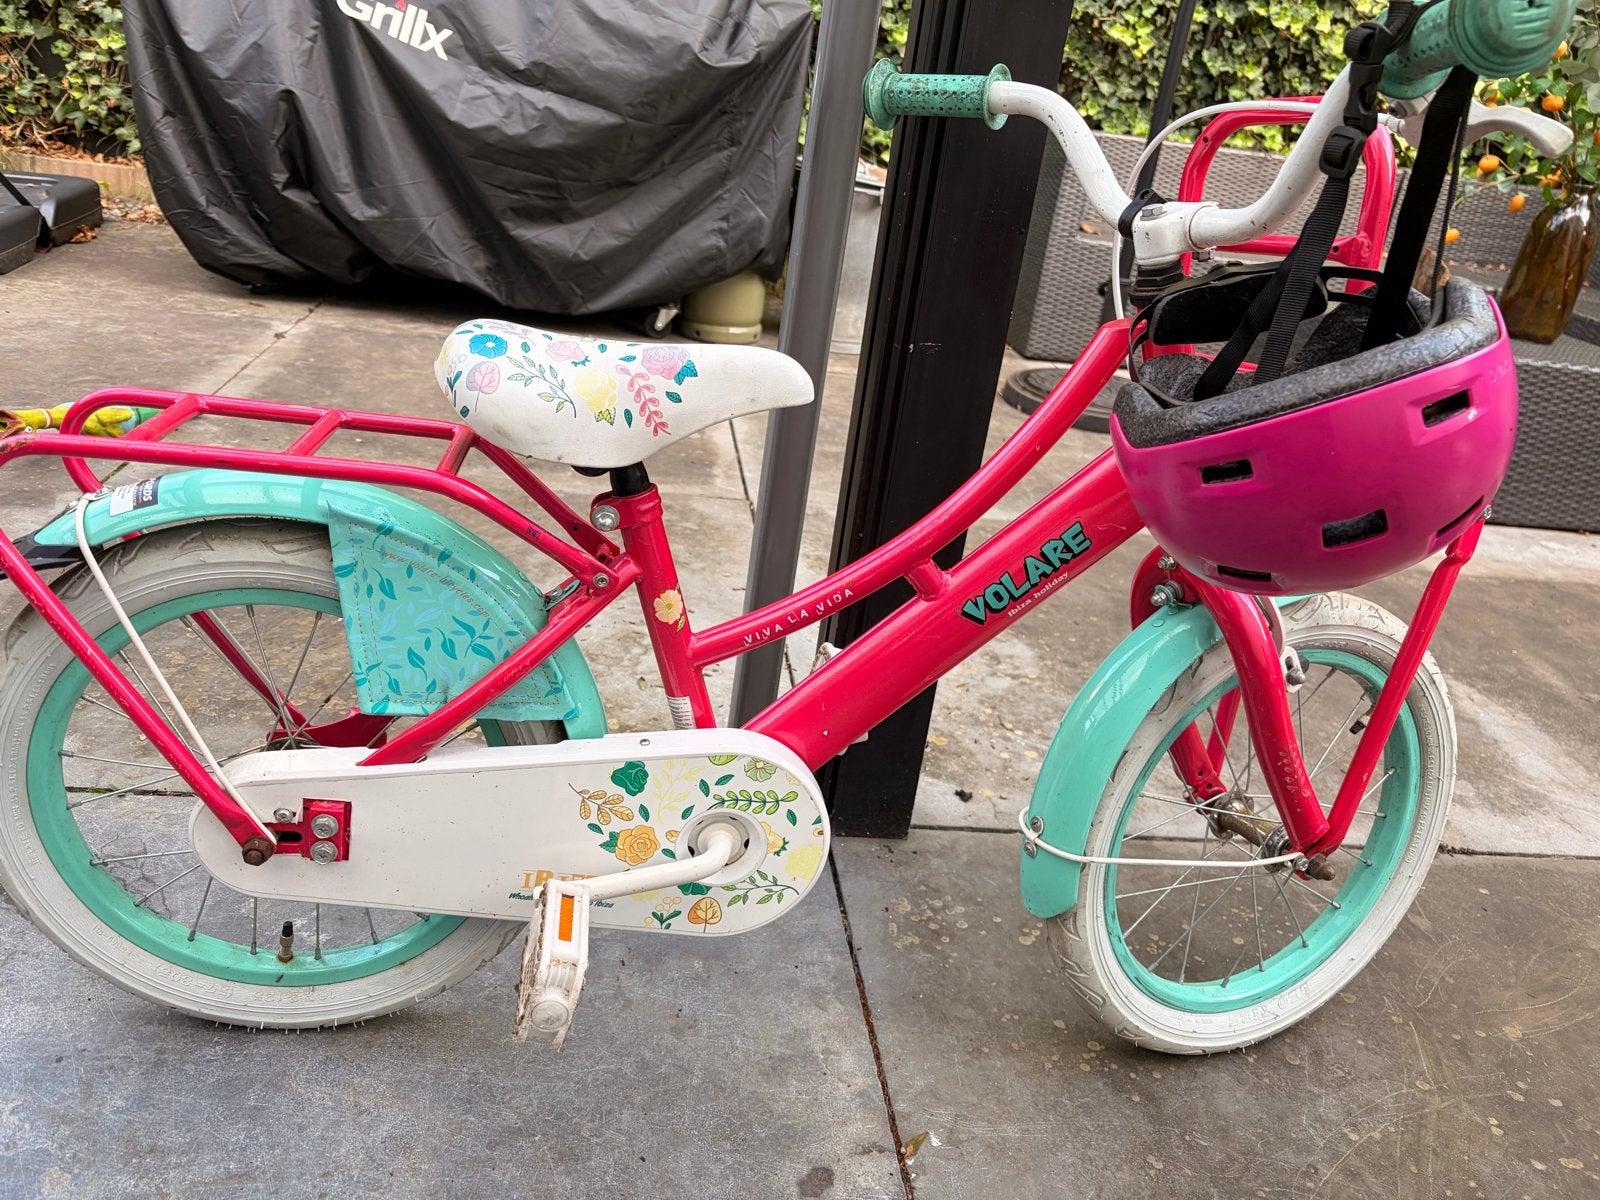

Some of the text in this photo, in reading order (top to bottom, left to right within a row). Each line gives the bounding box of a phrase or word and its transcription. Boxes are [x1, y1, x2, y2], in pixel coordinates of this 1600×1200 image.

[336, 0, 454, 61] Grillx
[961, 521, 1093, 626] VOLARE
[1033, 571, 1069, 599] holiday
[744, 588, 854, 644] VIVA LA VIDA
